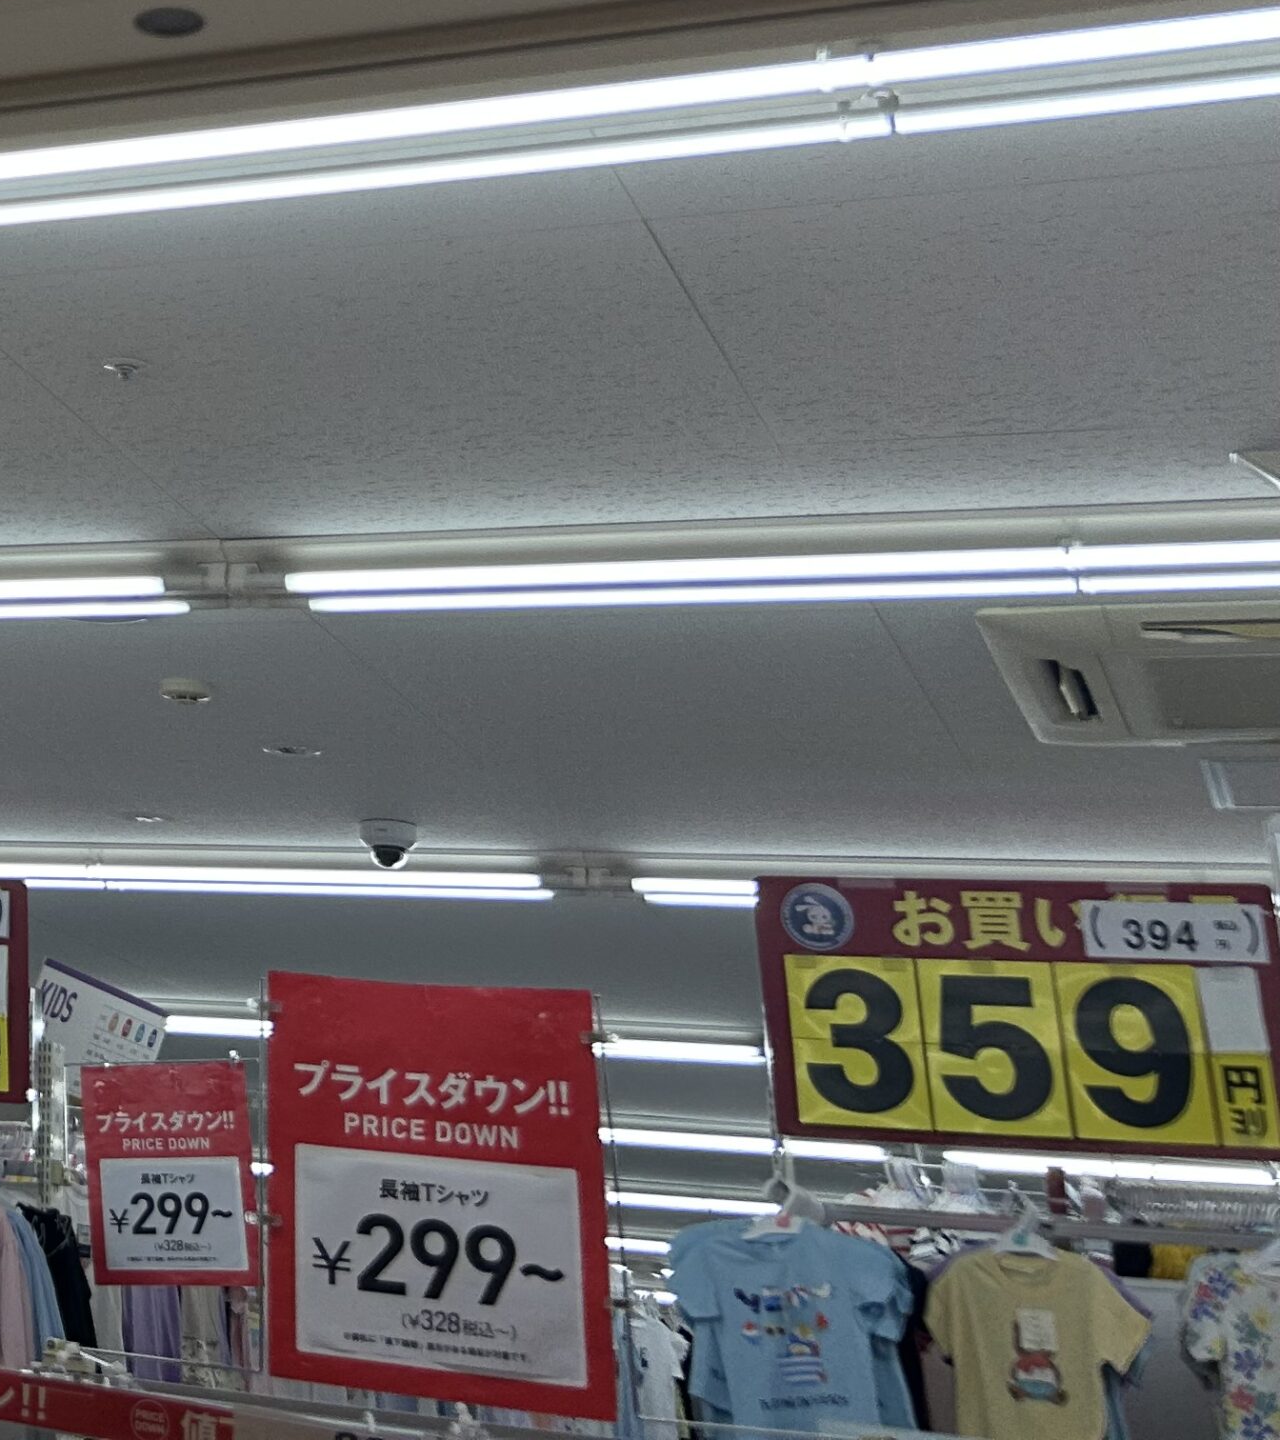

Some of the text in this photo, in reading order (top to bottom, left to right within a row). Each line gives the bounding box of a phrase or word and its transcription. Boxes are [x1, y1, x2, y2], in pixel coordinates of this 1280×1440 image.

[41, 979, 78, 1022] KIDS
[804, 967, 1195, 1129] 359
[293, 1059, 571, 1116] プライスダウン!!
[122, 1136, 210, 1151] PRICE DOWN
[344, 1112, 519, 1149] PRICE DOWN
[141, 1173, 195, 1185] 長袖Tシャツ
[378, 1178, 489, 1207] 長袖Tシャツ
